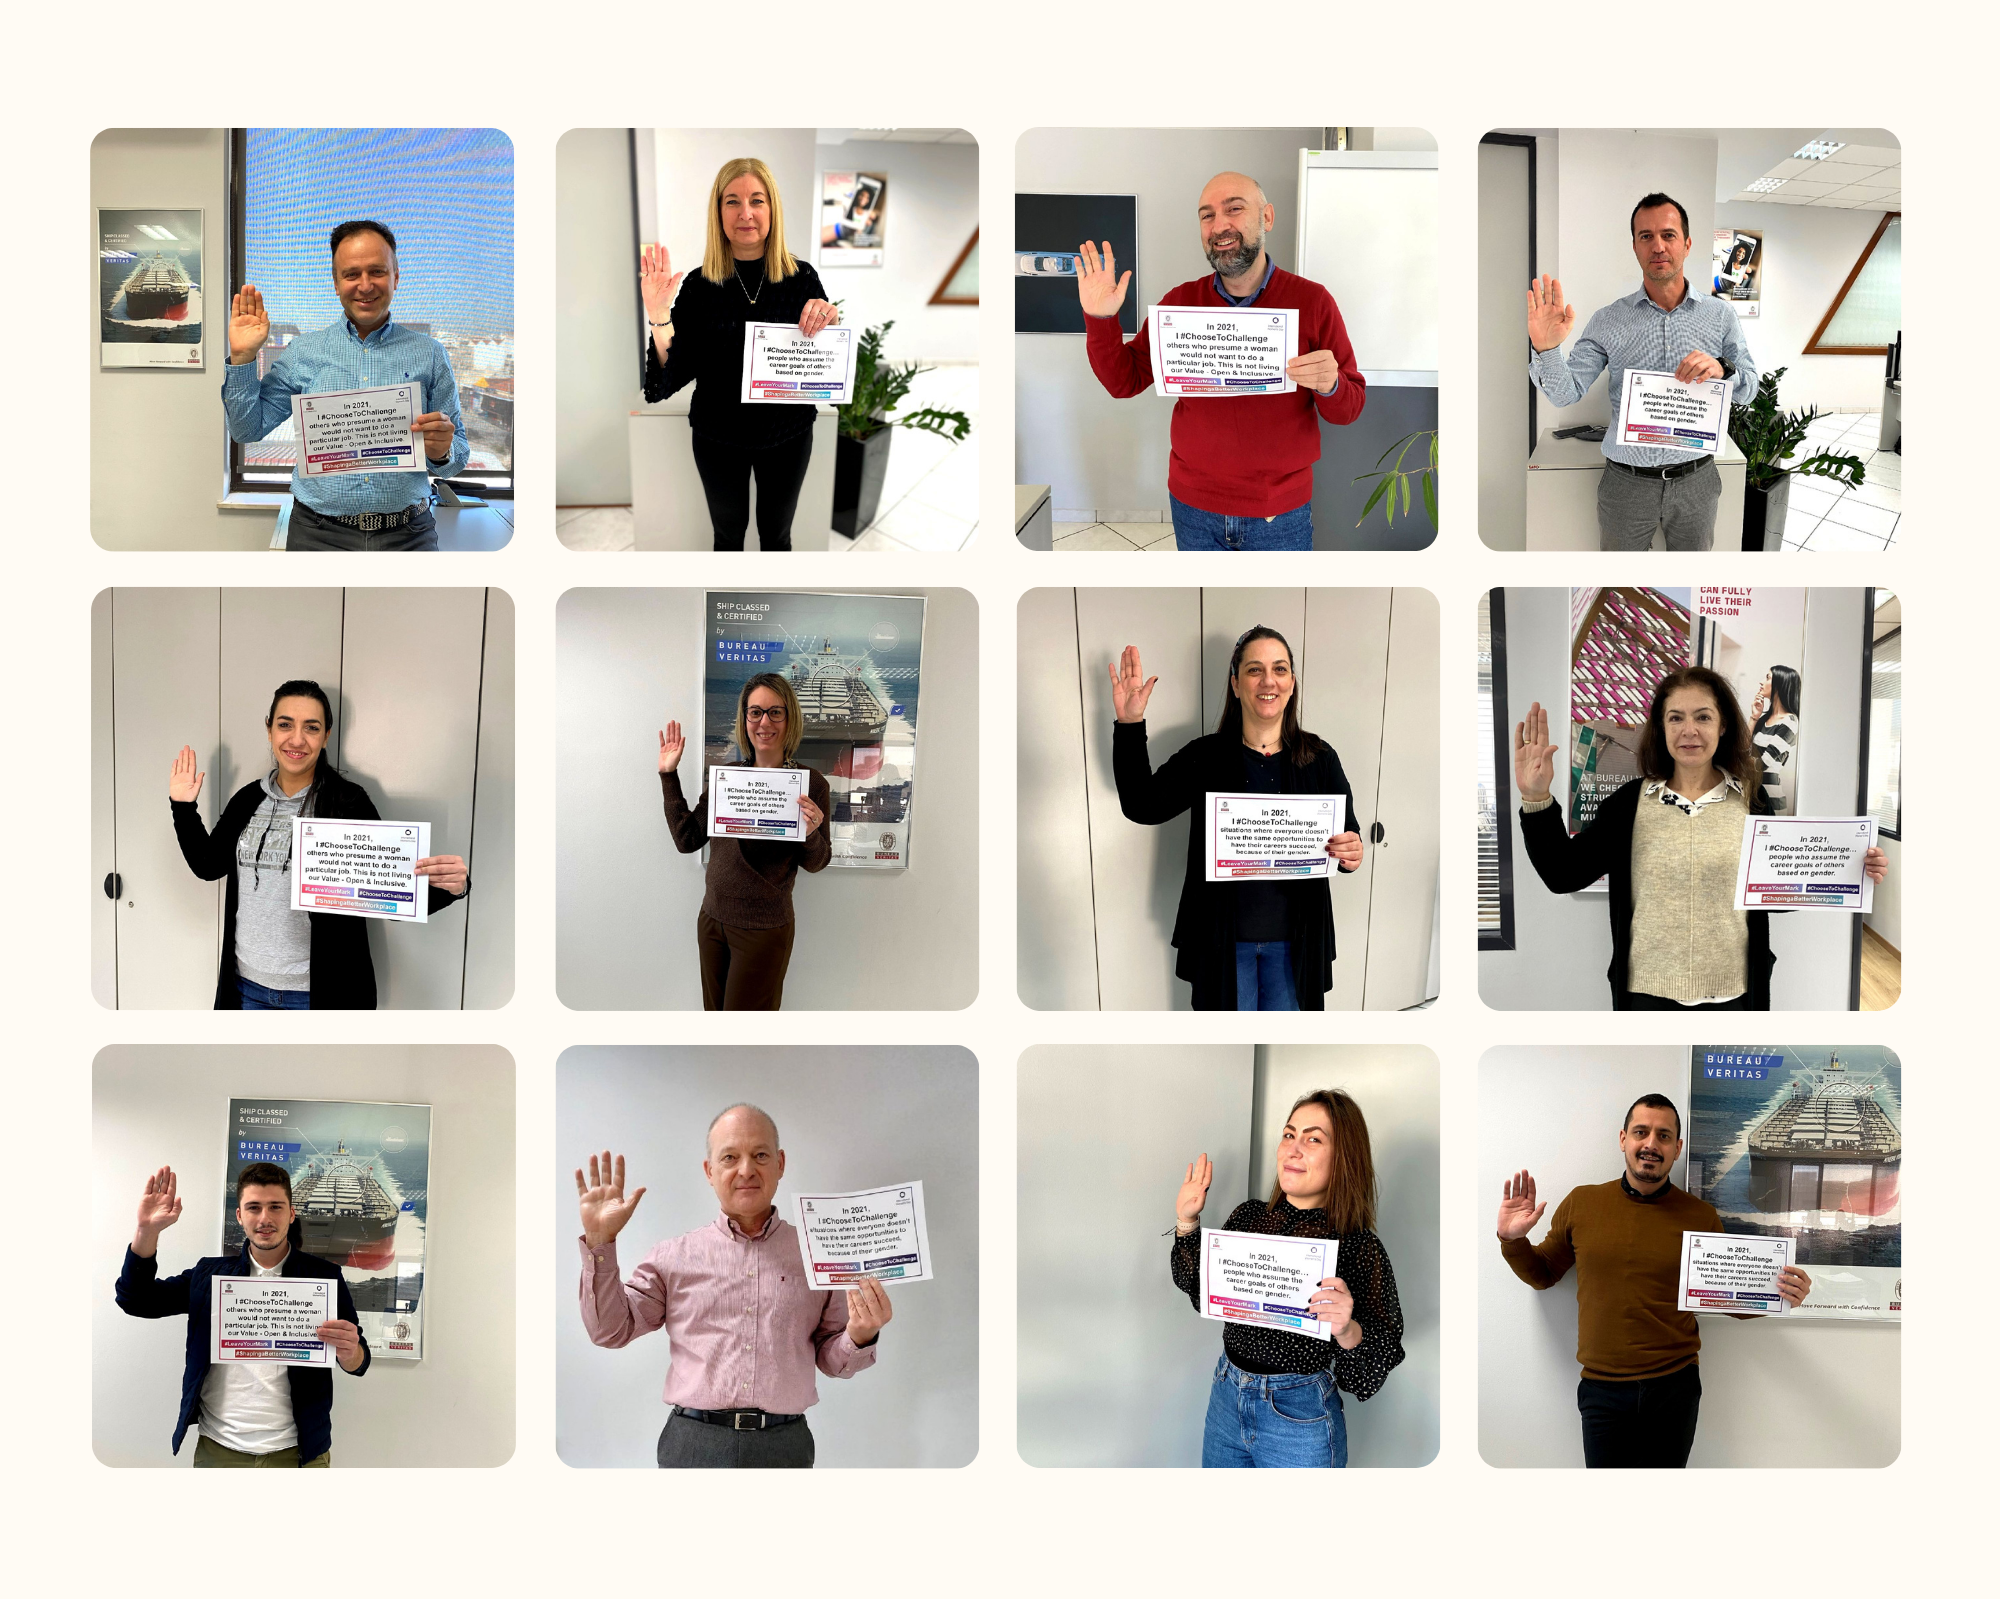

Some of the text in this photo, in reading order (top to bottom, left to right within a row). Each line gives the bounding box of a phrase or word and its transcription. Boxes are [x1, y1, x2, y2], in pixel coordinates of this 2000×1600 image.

[1217, 324, 1239, 332] 2021,
[1181, 333, 1268, 343] #ChooseToChallenge
[322, 408, 396, 420] #ChooseToChallenge
[1722, 587, 1752, 596] FULLY
[1700, 597, 1751, 606] LIVE THEIR
[1700, 607, 1739, 616] PASSION
[716, 627, 724, 635] by
[719, 642, 766, 650] BUREAU
[719, 654, 766, 662] VERITAS
[1236, 818, 1317, 827] #ChooseToChallenge
[320, 842, 400, 853] #ChooseToChallenge
[305, 887, 351, 895] #LeaveYourMark
[360, 891, 412, 900] #ChooseToChallenge
[1708, 1055, 1761, 1065] BUREAU
[1708, 1069, 1761, 1078] VERITAS
[241, 1142, 284, 1150] BUREAU
[857, 1229, 898, 1239] opportunities
[1258, 1254, 1277, 1263] 2021,
[1706, 1253, 1773, 1263] #ChooseToChallenge
[1224, 1268, 1245, 1277] people
[1248, 1280, 1266, 1288] goals
[1265, 1290, 1291, 1299] gender.
[240, 1299, 313, 1307] #ChooseToChallenge
